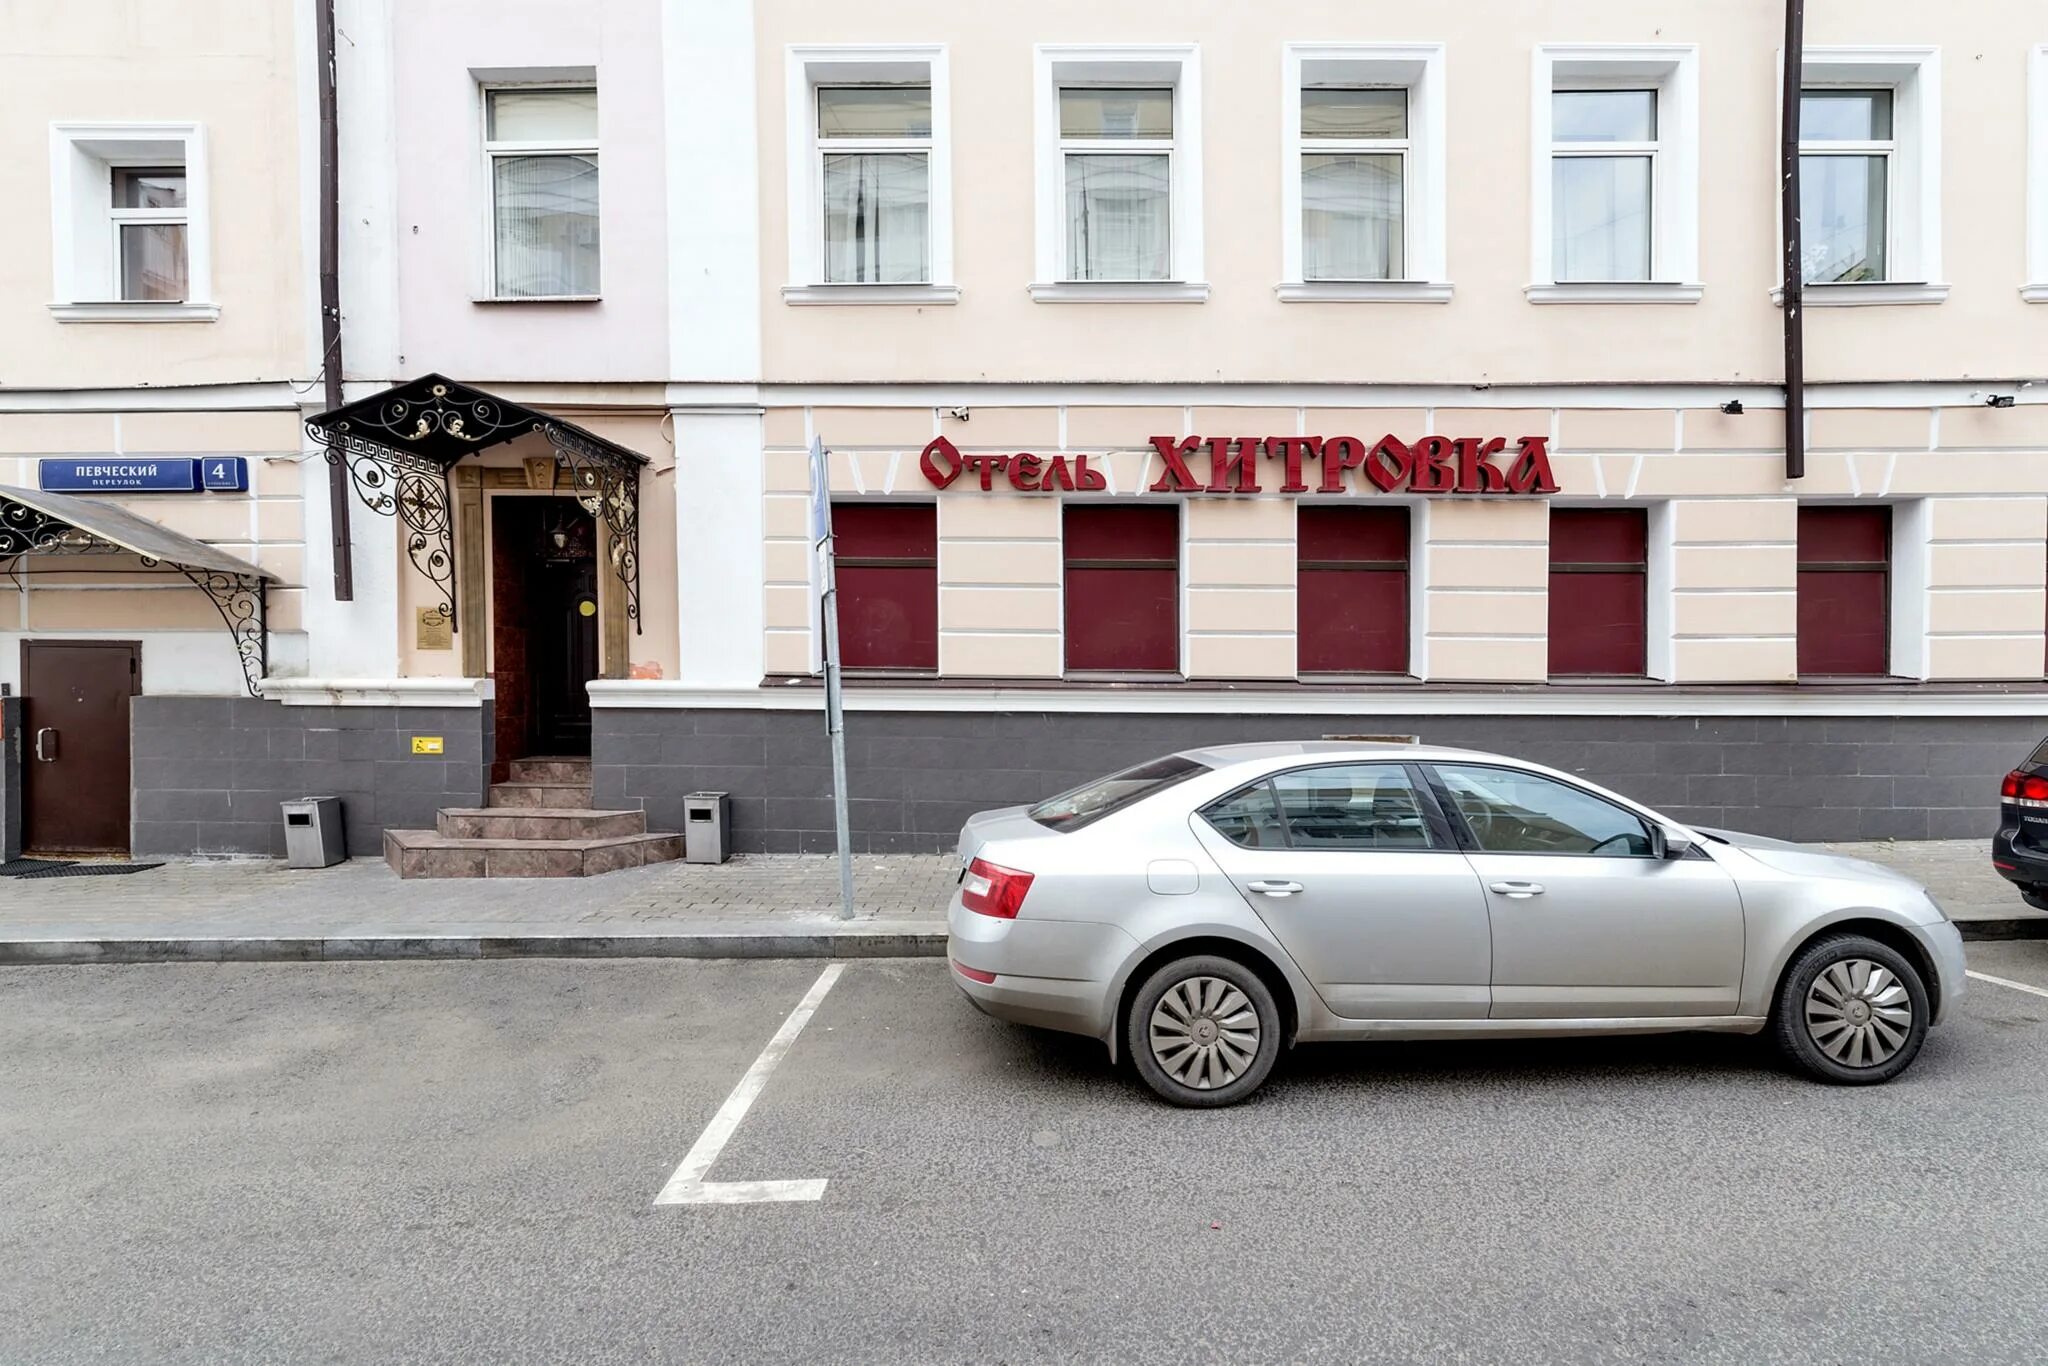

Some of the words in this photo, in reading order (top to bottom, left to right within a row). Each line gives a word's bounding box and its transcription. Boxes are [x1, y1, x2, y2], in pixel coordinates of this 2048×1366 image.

[75, 464, 158, 477] ПЕВЧЕСКИЙ
[211, 463, 226, 479] 4
[919, 435, 1107, 491] Отель
[1148, 434, 1561, 494] ХИТРОВКА
